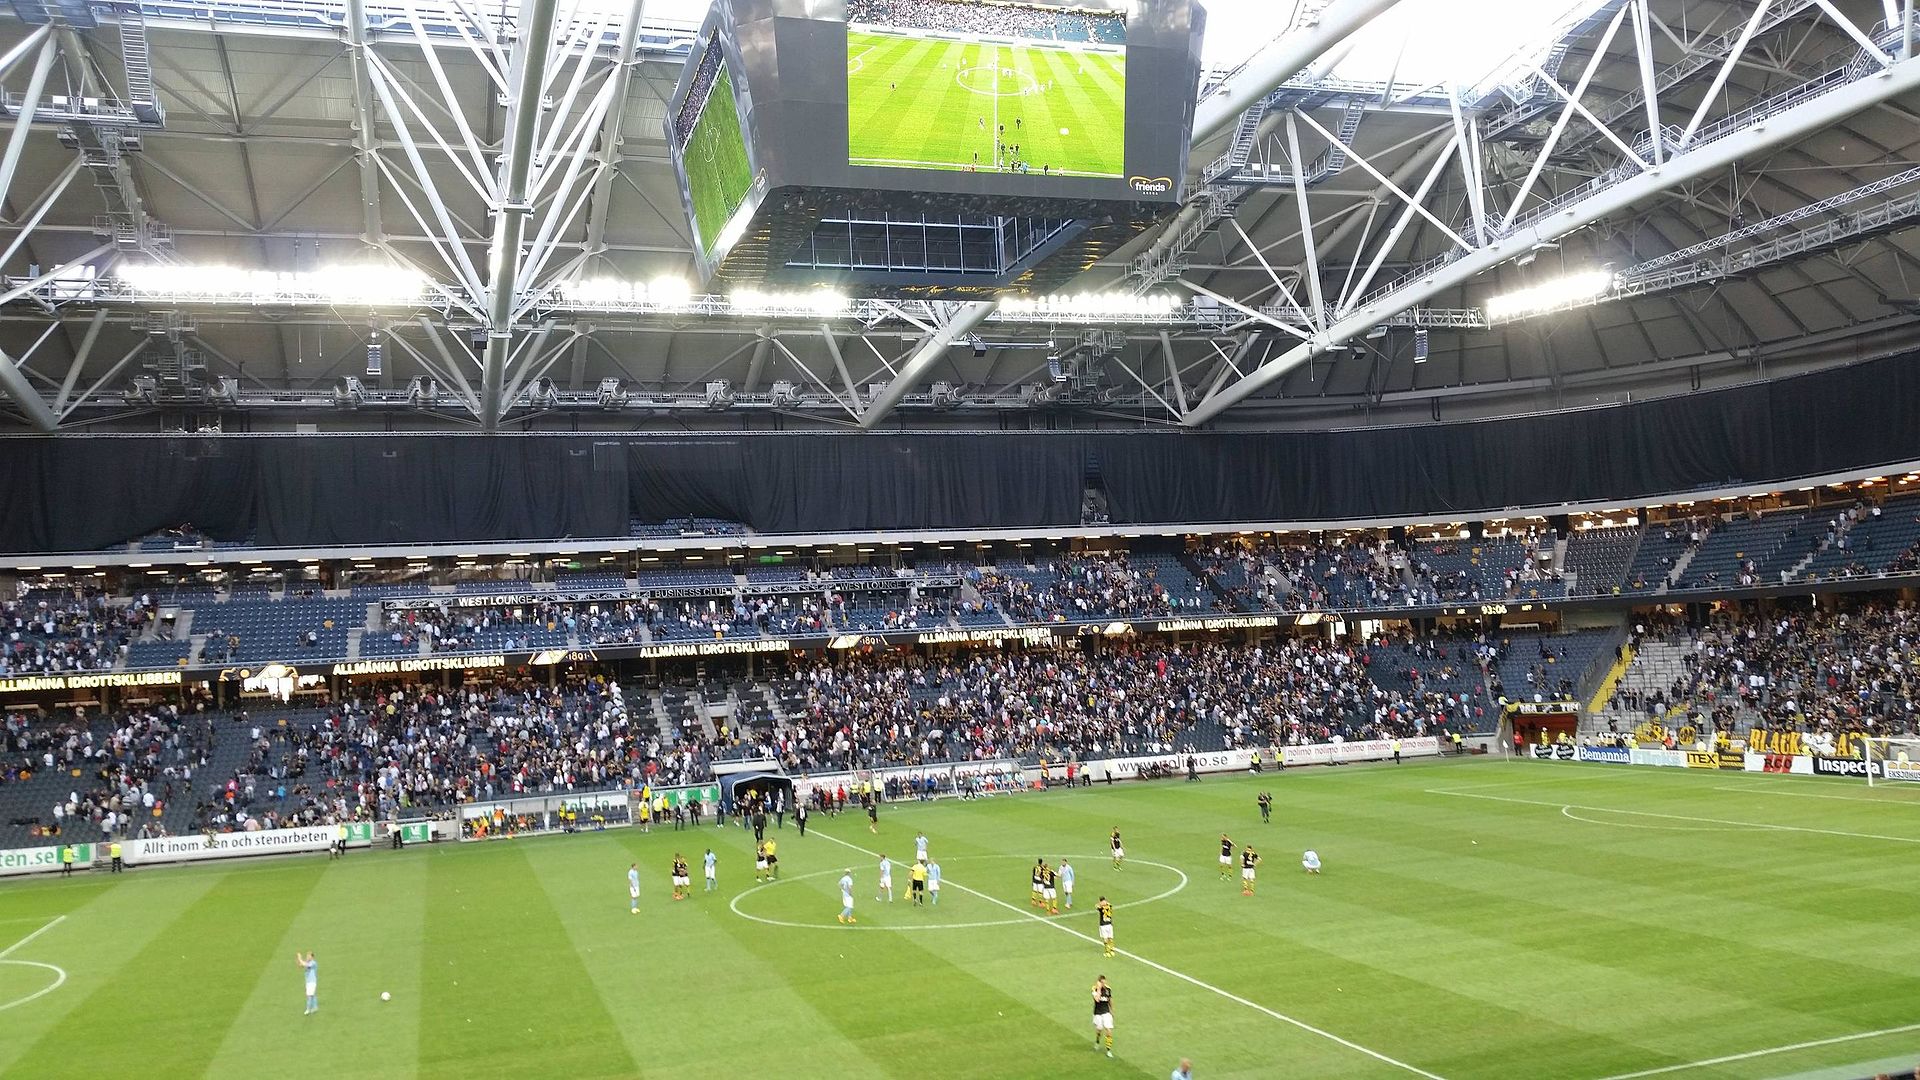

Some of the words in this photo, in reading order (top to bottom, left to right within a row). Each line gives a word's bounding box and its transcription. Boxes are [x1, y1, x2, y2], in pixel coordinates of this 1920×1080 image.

[1135, 181, 1166, 192] friends
[459, 598, 487, 606] WEST
[490, 595, 532, 605] LOUNGE
[655, 589, 700, 598] BUSINESS
[1481, 604, 1507, 615] 93:06
[1158, 621, 1203, 631] ALLMÄNNA
[1205, 617, 1278, 630] IDROTTSKLUBBEN
[919, 632, 969, 643] ALLMÄNNA
[640, 645, 697, 658] ALLMÄNNA
[700, 641, 789, 654] IDROTTSKLUBBEN
[333, 661, 398, 675] ALLMÄNNA
[401, 656, 504, 671] IDROTTSKLUBBEN
[68, 672, 181, 688] IDROTTSKLUBBEN
[1750, 729, 1801, 754] BLACK
[1580, 747, 1630, 763] Bemannia
[1687, 753, 1716, 764] ITEX
[1819, 758, 1880, 774] Inspeca
[143, 841, 165, 854] Allt
[168, 838, 199, 852] inom
[231, 834, 251, 847] och
[255, 831, 328, 846] stenarbeten
